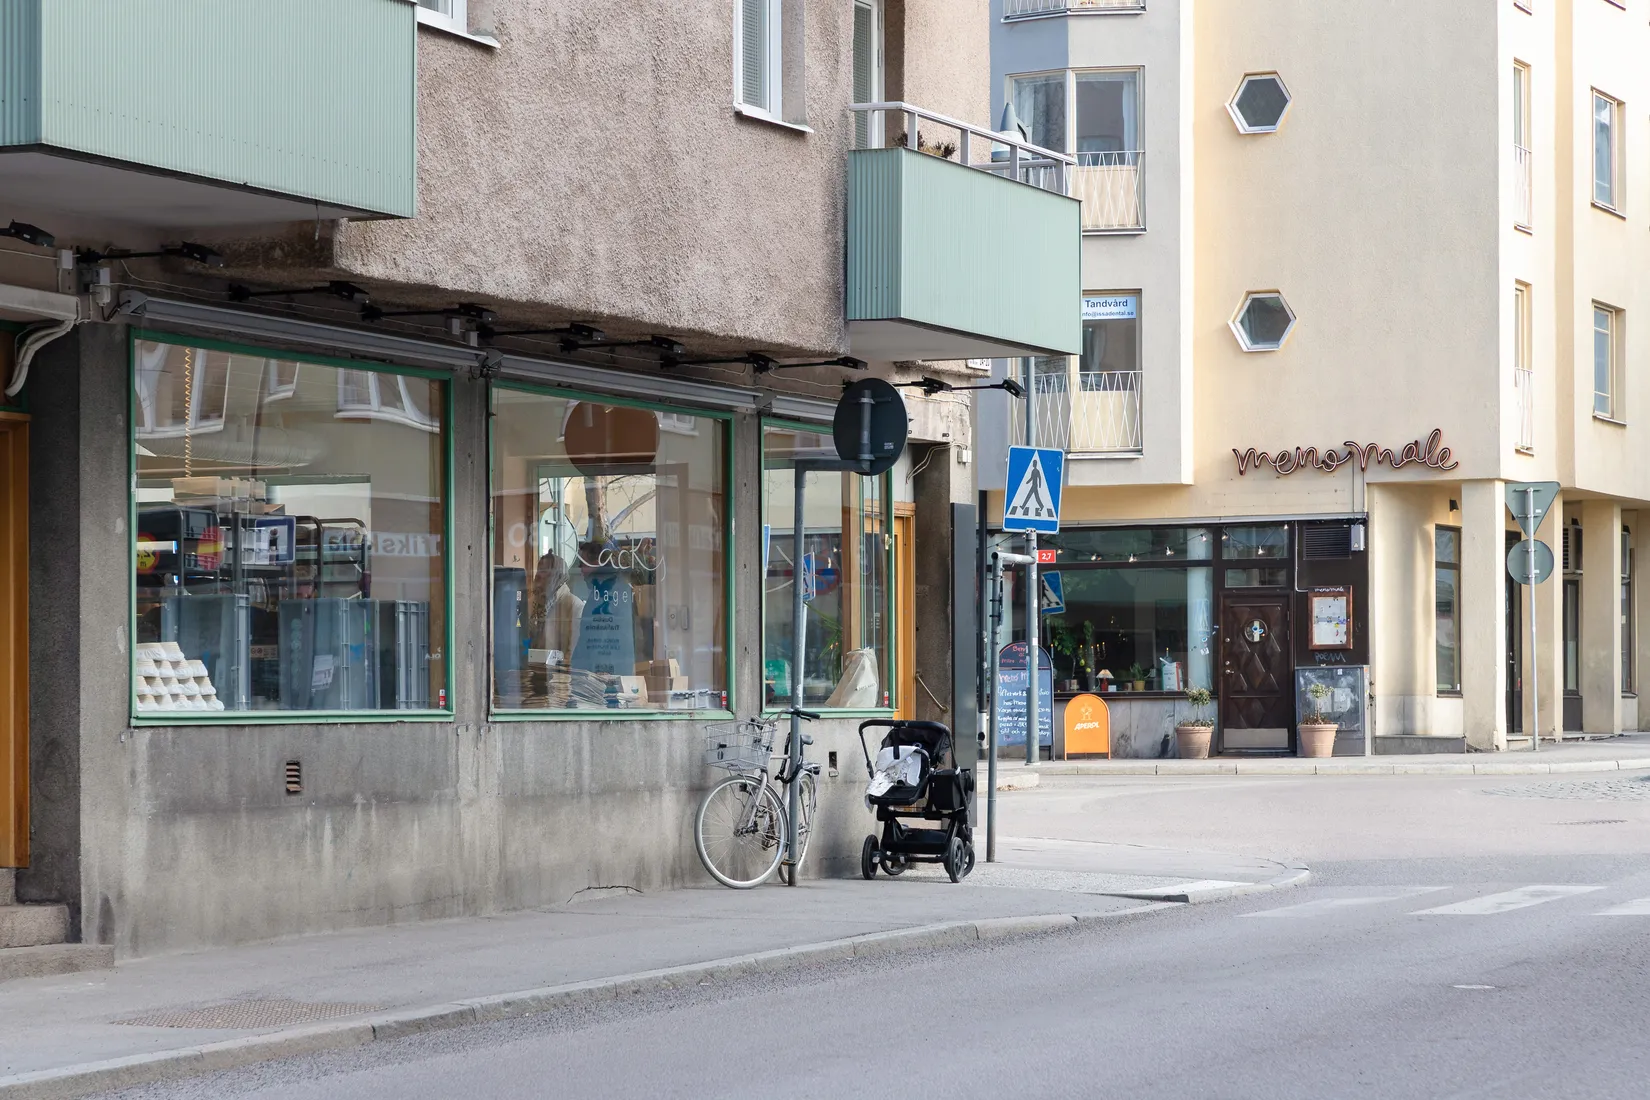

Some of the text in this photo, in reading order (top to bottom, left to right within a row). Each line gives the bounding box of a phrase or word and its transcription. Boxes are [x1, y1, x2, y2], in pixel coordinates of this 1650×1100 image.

[1085, 299, 1128, 308] Tandvård
[1041, 552, 1052, 561] 2,7
[593, 585, 642, 606] bageri
[1074, 721, 1100, 731] APEROL
